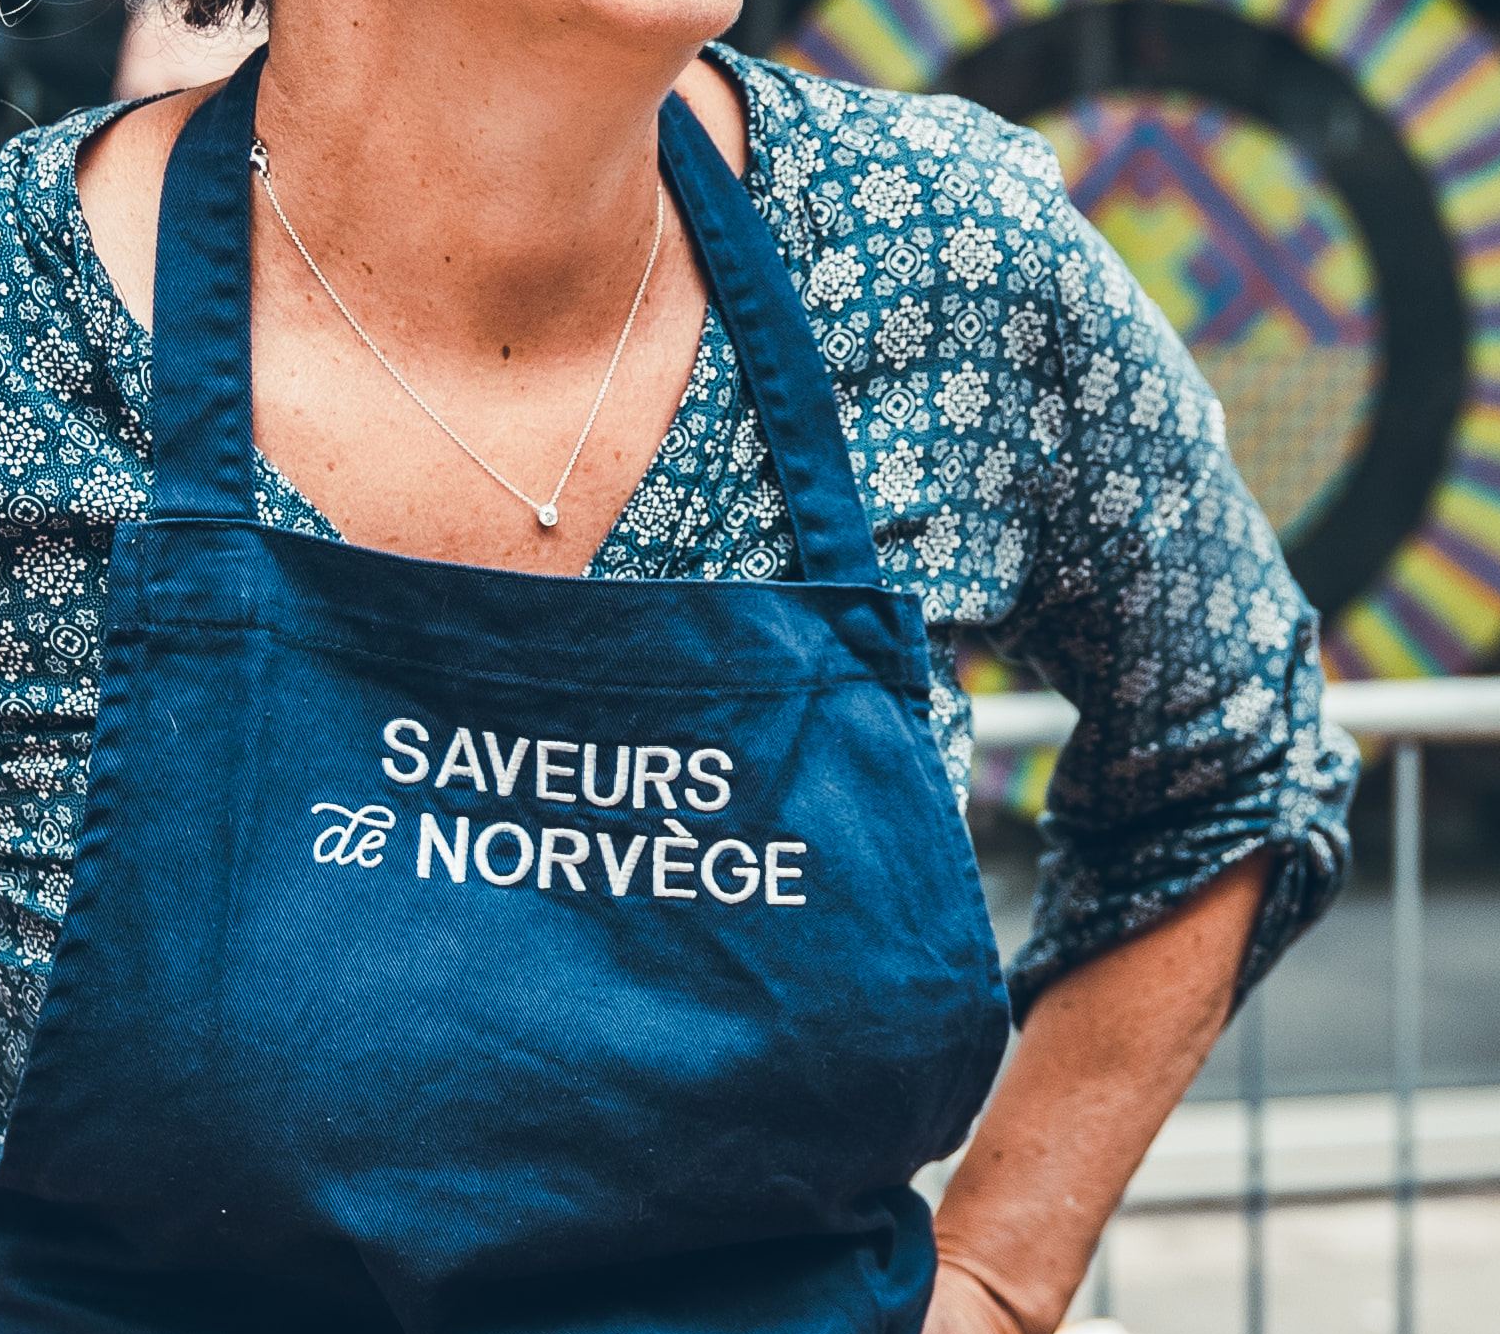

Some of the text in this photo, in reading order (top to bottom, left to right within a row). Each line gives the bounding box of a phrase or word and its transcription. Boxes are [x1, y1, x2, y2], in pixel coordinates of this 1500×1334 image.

[381, 717, 734, 812] SAVEURS
[310, 801, 807, 906] de NORVÈGE
